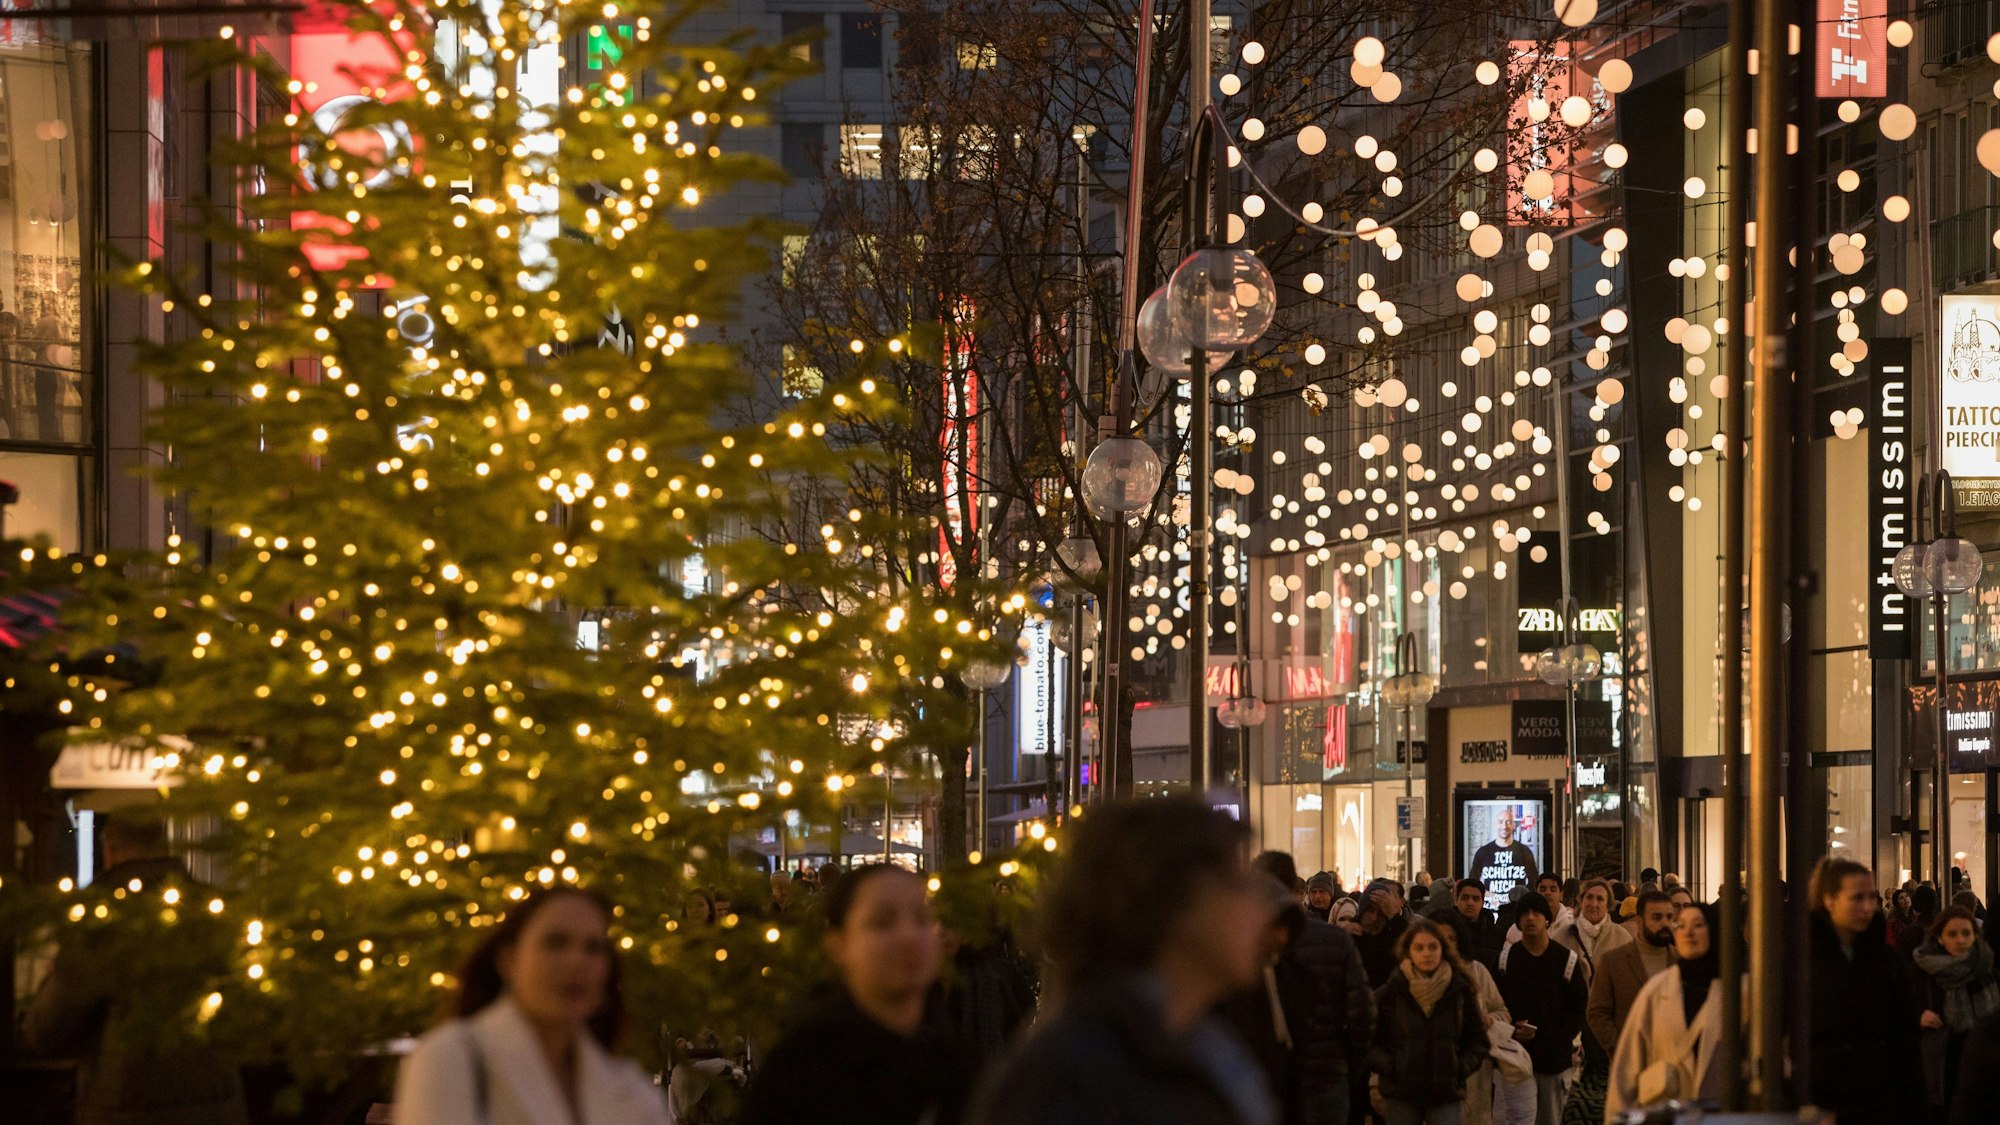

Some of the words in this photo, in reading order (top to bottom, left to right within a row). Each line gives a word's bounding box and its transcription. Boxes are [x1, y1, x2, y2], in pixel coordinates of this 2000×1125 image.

[1946, 431, 2000, 448] PIERCI
[1877, 366, 1904, 631] intimissimi
[1520, 717, 1559, 726] VERO
[1518, 728, 1561, 738] MODA
[1494, 851, 1512, 864] ICH
[1482, 864, 1525, 879] SCHÜTZE
